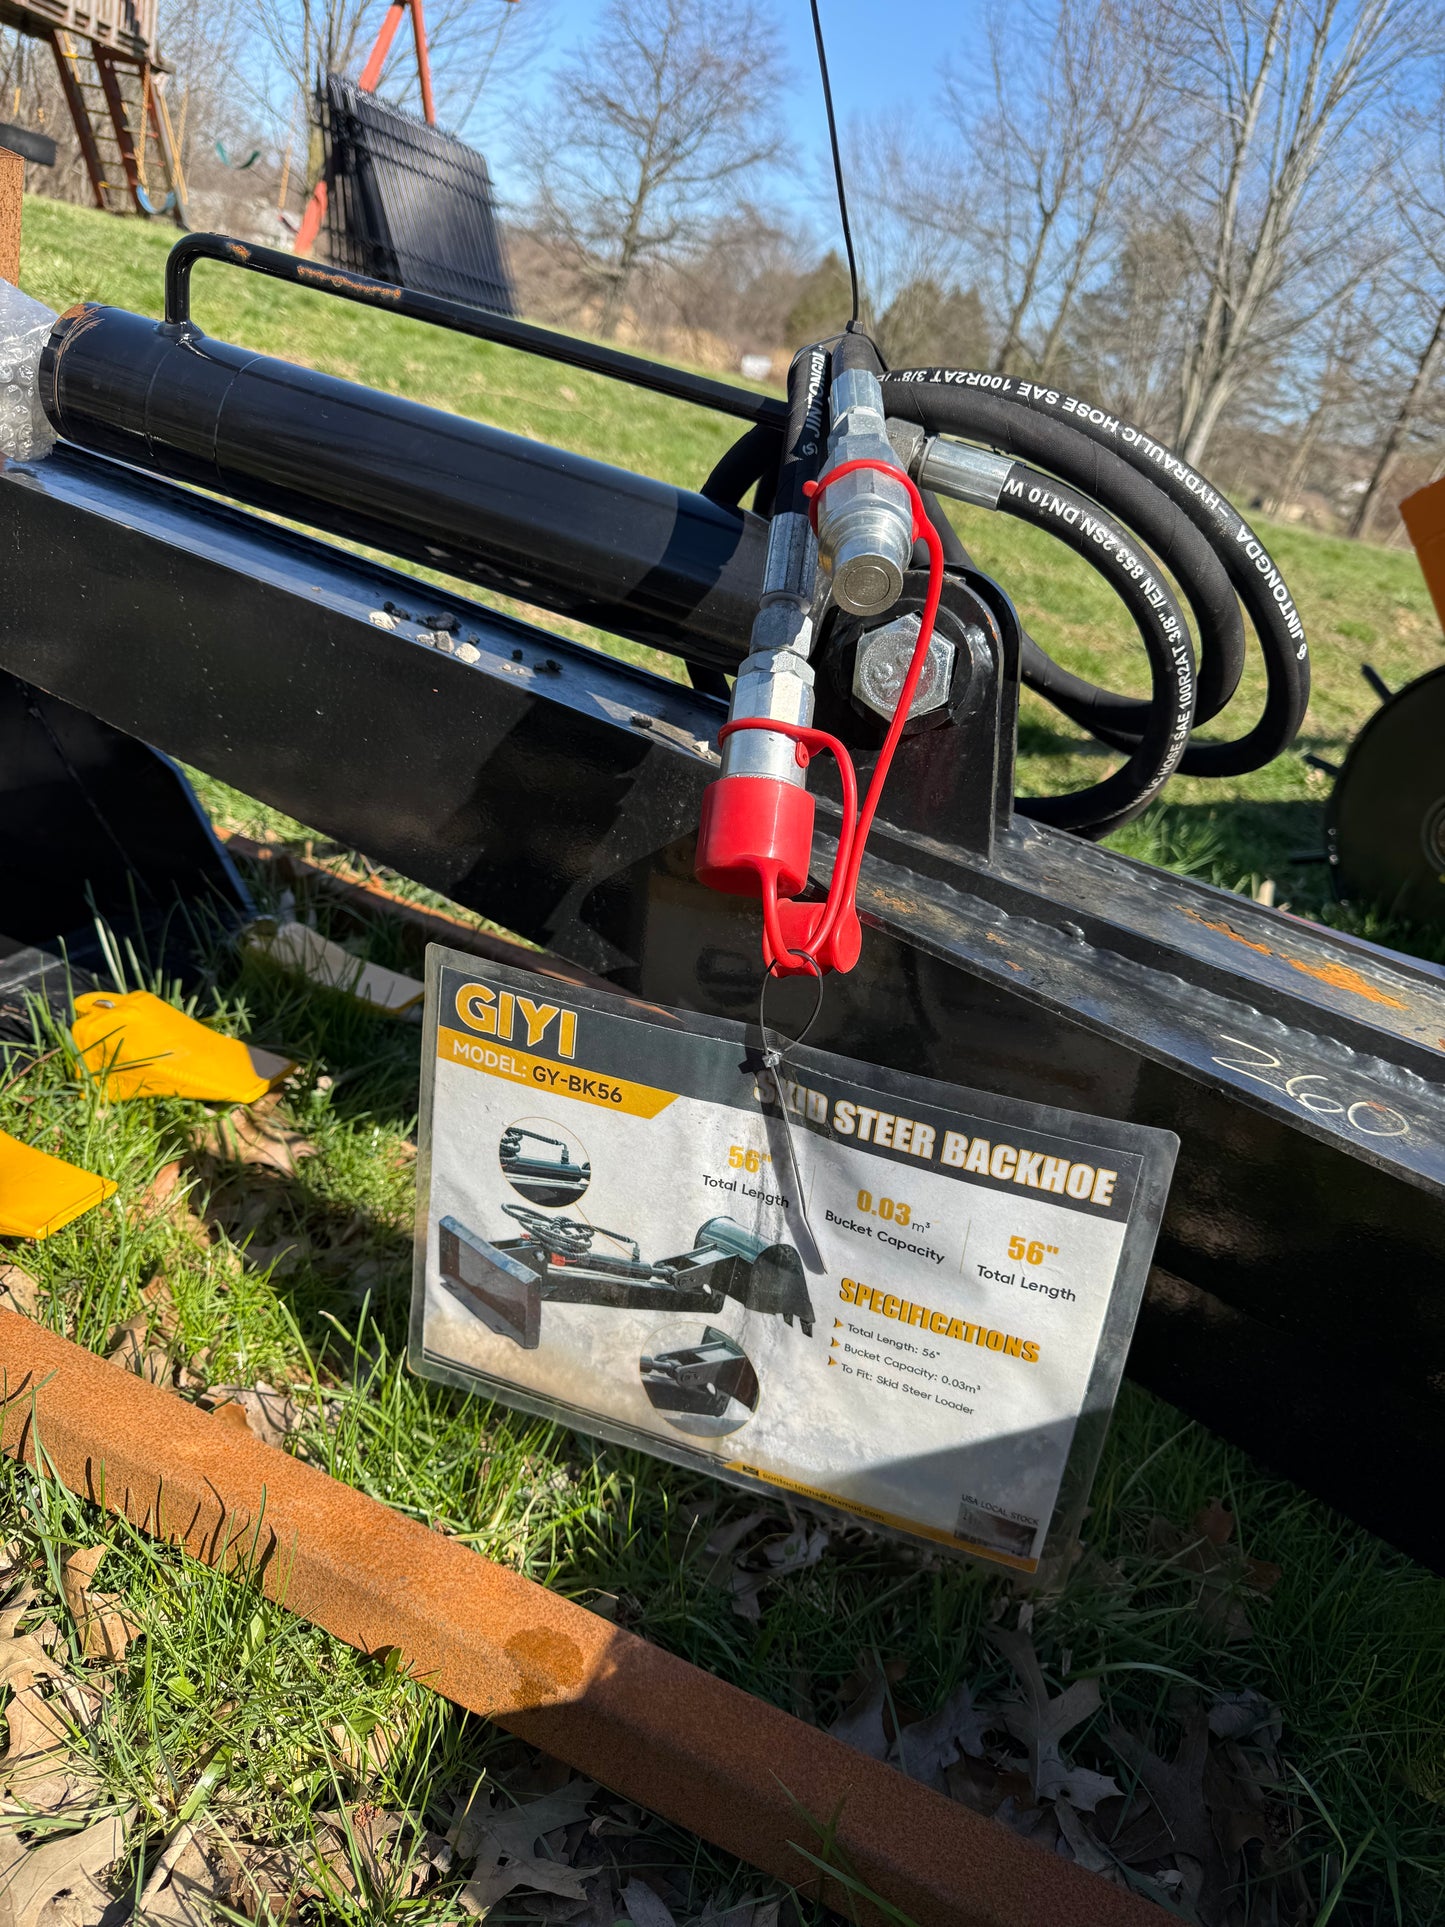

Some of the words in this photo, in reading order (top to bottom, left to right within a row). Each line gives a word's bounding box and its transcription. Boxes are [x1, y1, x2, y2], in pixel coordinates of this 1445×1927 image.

[929, 370, 1012, 392] 100R2AT
[1017, 382, 1060, 405] SAE
[1061, 396, 1120, 433] HOSE
[1028, 487, 1080, 525] DN10
[1079, 517, 1118, 551] 2SN
[1115, 548, 1144, 580] 853
[1235, 524, 1304, 639] JINTONGDA
[1171, 645, 1192, 710] 100R2AT
[1174, 710, 1191, 741] SAE
[1157, 744, 1182, 776] HOSE
[455, 982, 577, 1059] GIYI
[452, 1040, 526, 1078] MODEL:
[532, 1065, 623, 1104] GY-BK56
[1211, 1034, 1409, 1137] 260
[753, 1069, 828, 1124] SKID
[833, 1099, 937, 1159] STEER
[940, 1130, 1118, 1207] BACKHOE
[702, 1174, 737, 1192] Total
[741, 1183, 790, 1208] Length
[825, 1209, 873, 1237] Bucket
[877, 1230, 946, 1265] Capacity
[1007, 1235, 1060, 1266] 56"
[977, 1264, 1015, 1286] Total
[1019, 1276, 1076, 1302] Length
[838, 1277, 1041, 1363] SPECIFICATIONS
[847, 1323, 874, 1339] Total
[876, 1333, 919, 1353] Length:
[844, 1343, 880, 1362] Bucket
[883, 1356, 938, 1381] Capacity:
[841, 1362, 853, 1374] To
[856, 1368, 873, 1381] Fit:
[876, 1375, 899, 1389] Skid
[902, 1383, 932, 1400] Steer
[935, 1394, 975, 1415] Loader
[960, 1493, 979, 1506] USA
[980, 1500, 1009, 1516] LOCAL
[1010, 1509, 1039, 1526] STOCK
